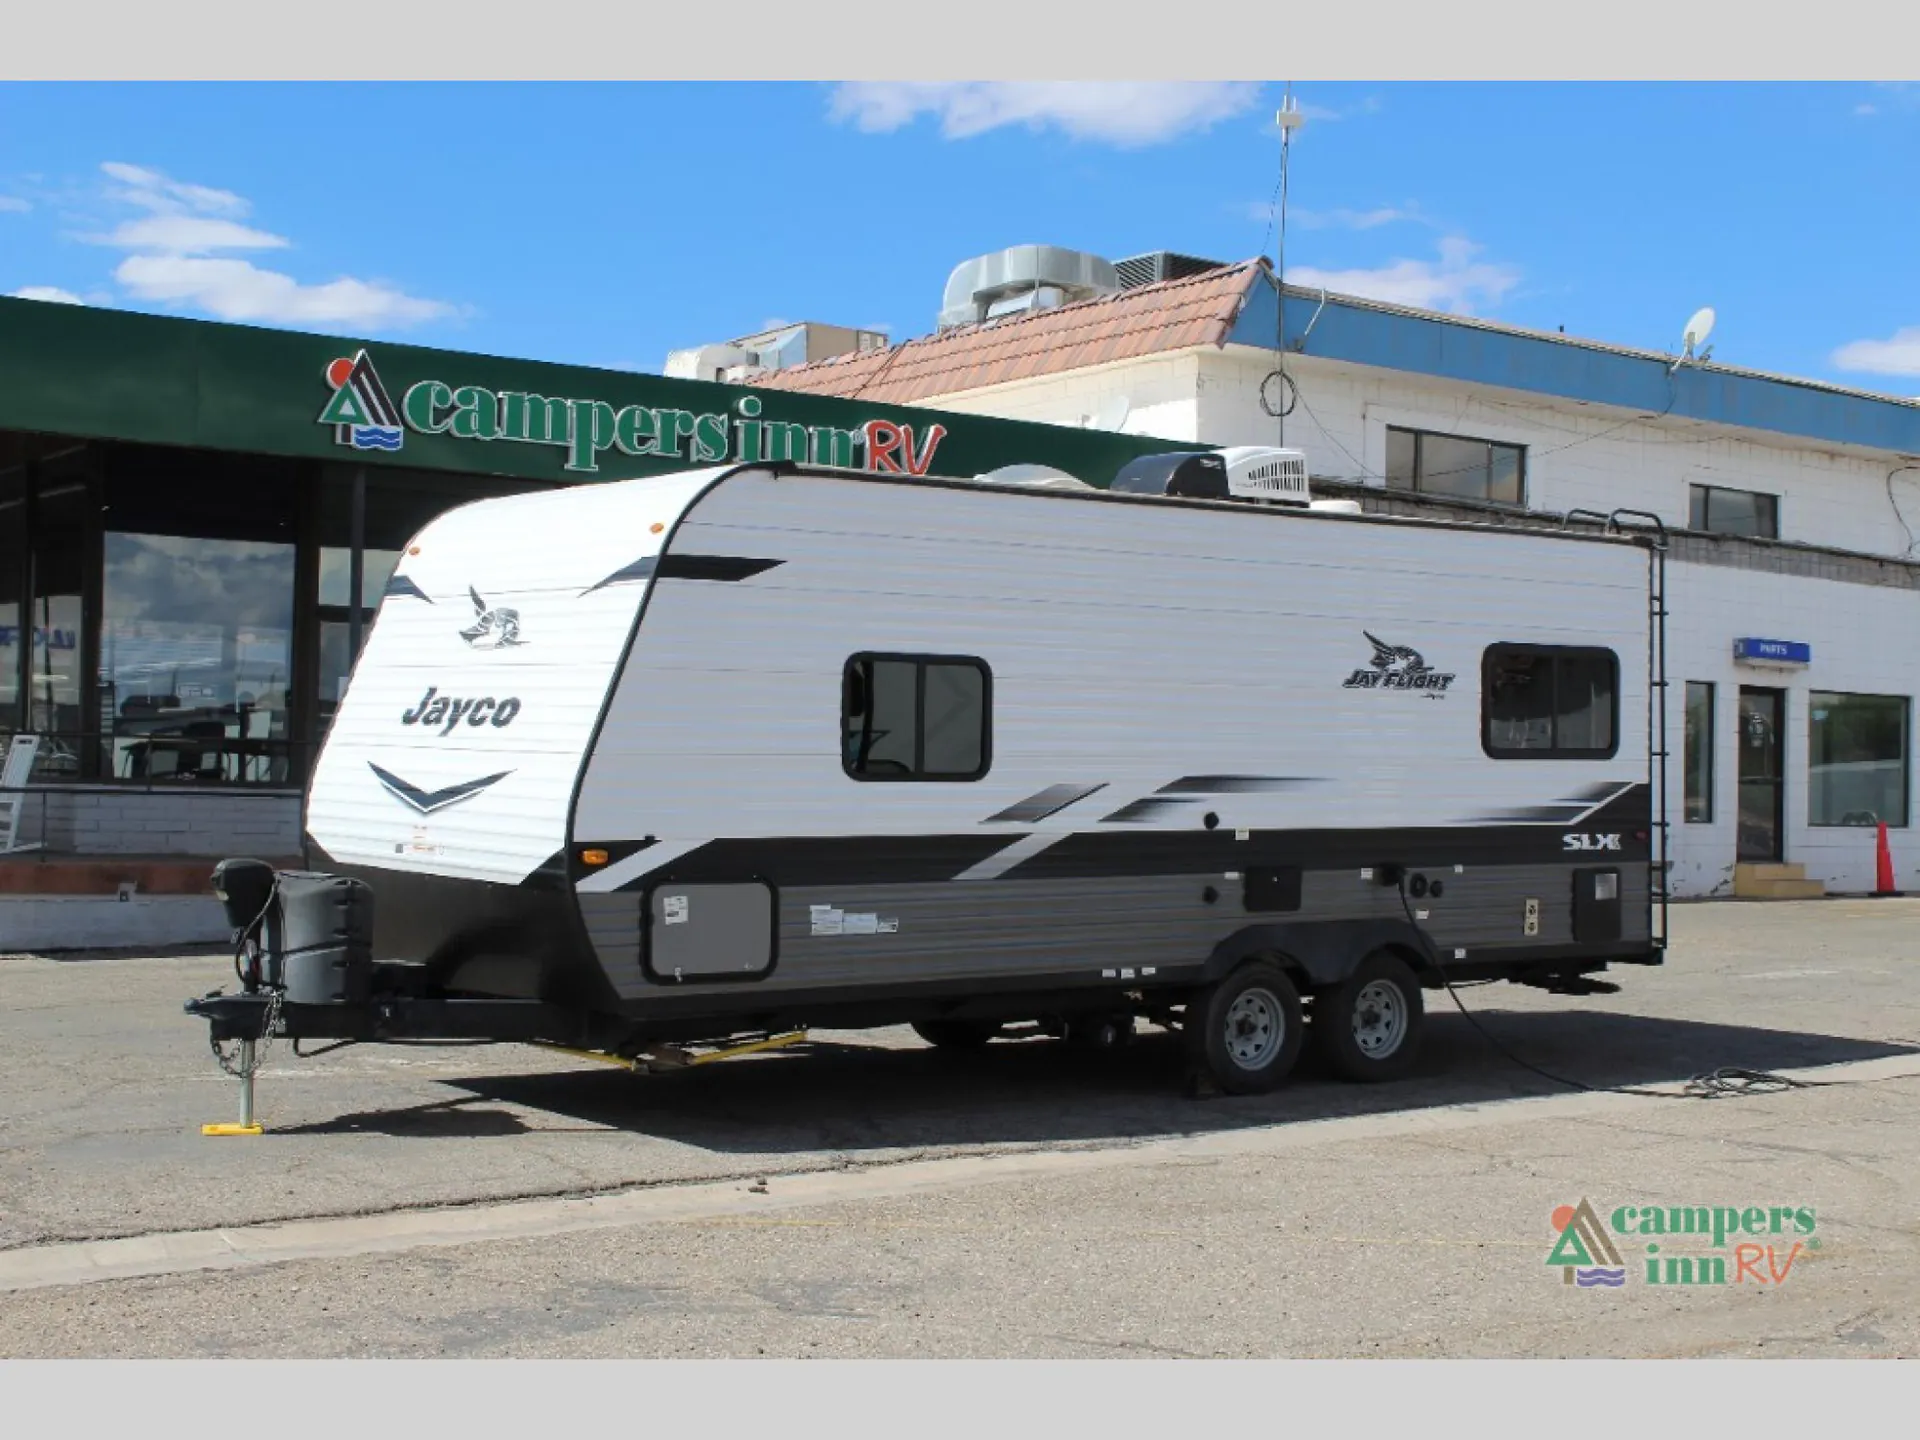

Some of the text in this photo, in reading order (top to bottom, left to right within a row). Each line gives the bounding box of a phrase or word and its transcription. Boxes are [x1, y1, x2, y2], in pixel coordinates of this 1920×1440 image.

[403, 379, 948, 477] campers inn RV
[1342, 669, 1456, 691] JAY FLIGHT
[402, 687, 521, 738] Jayco
[1562, 833, 1621, 851] SLX
